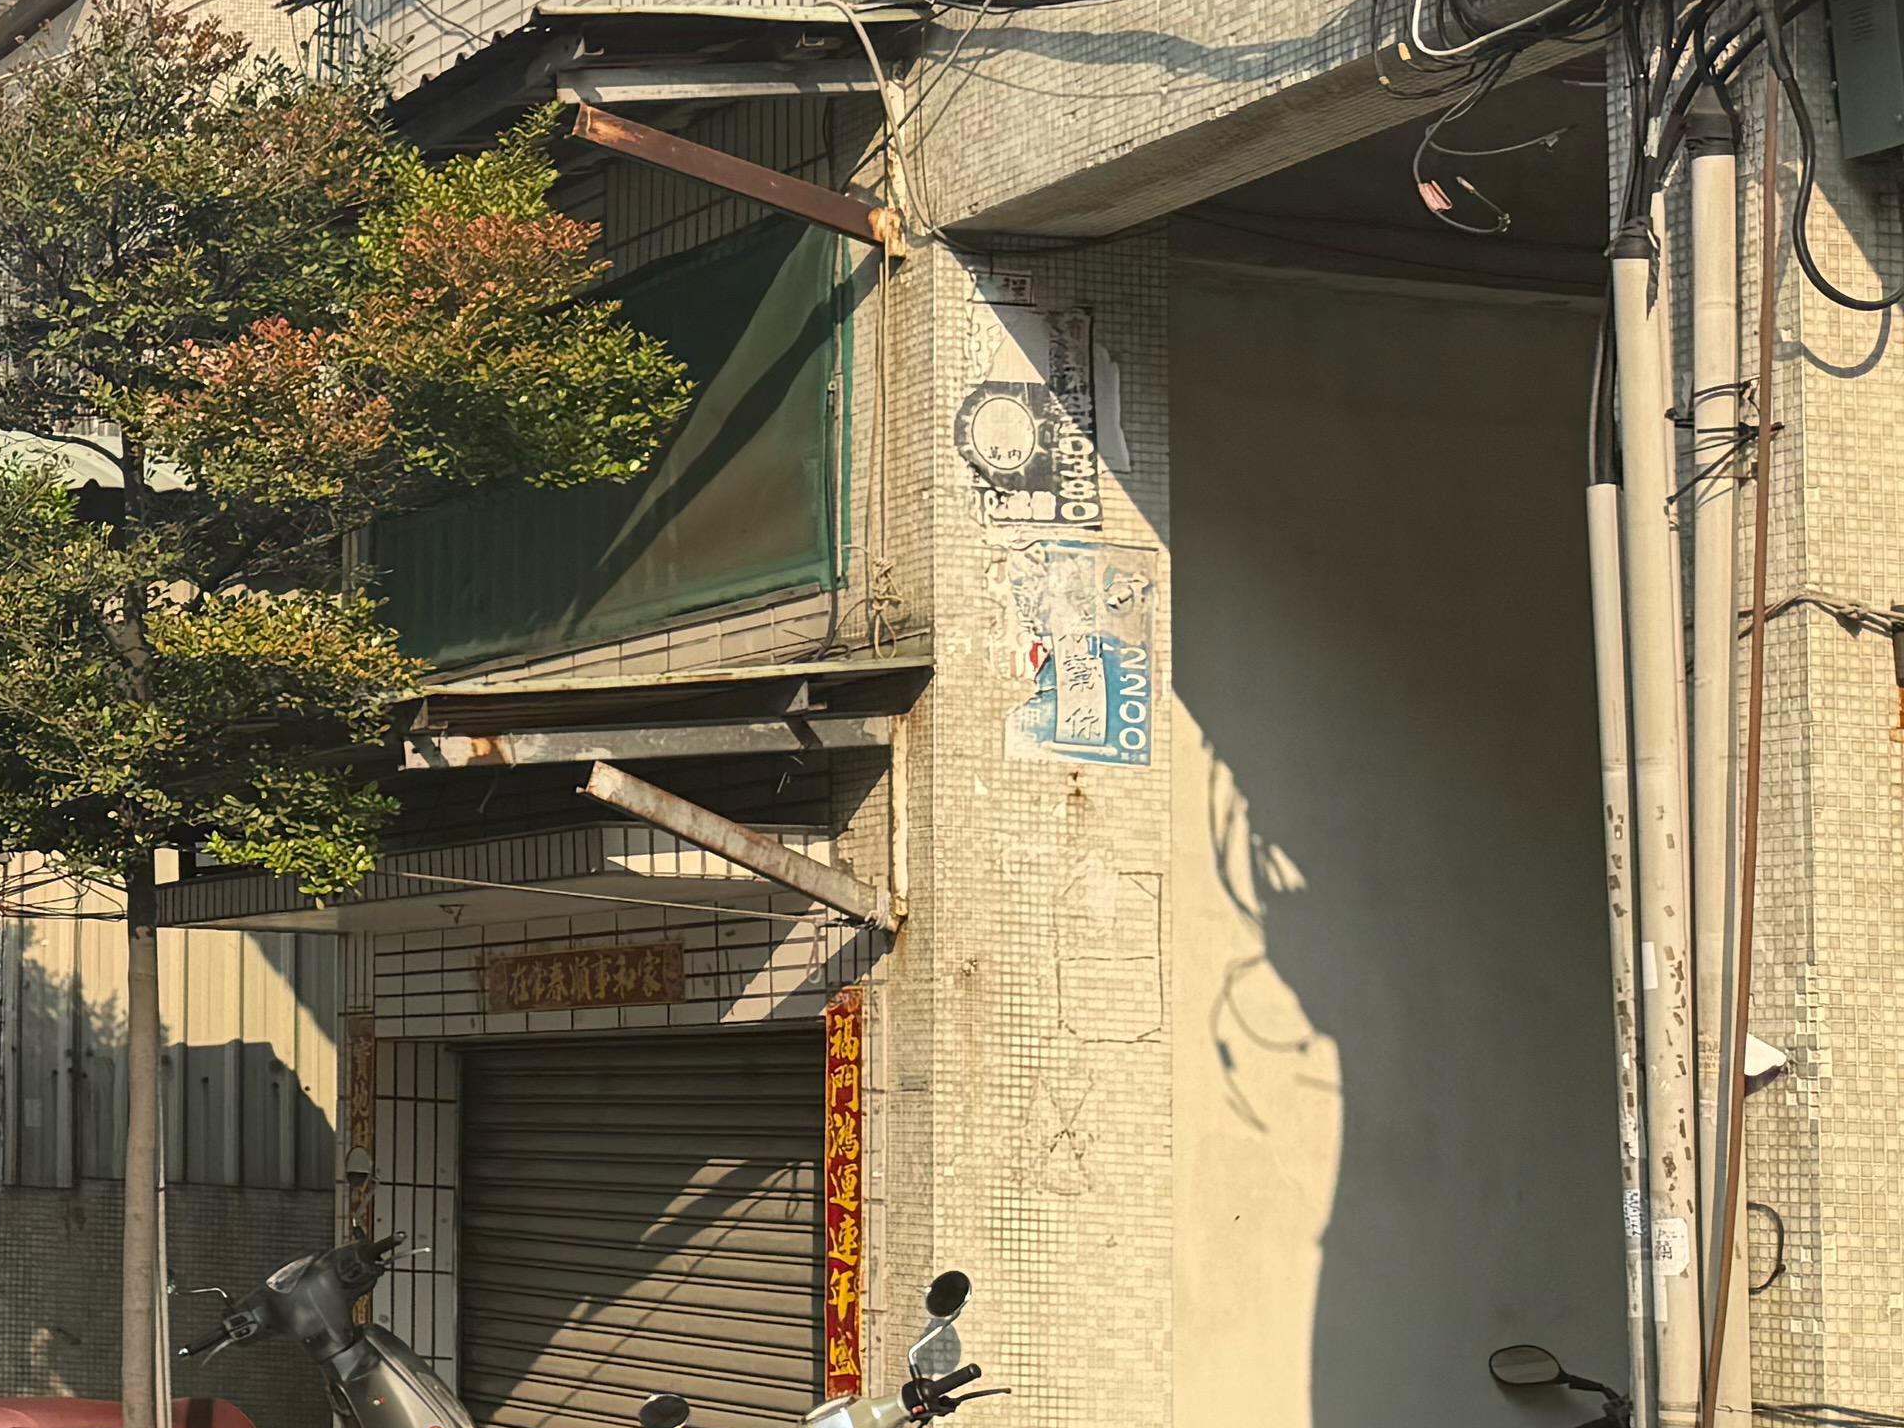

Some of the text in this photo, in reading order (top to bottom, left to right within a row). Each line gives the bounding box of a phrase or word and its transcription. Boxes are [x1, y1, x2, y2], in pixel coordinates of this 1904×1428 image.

[828, 1014, 861, 1376] 福門鴻運連年盛
